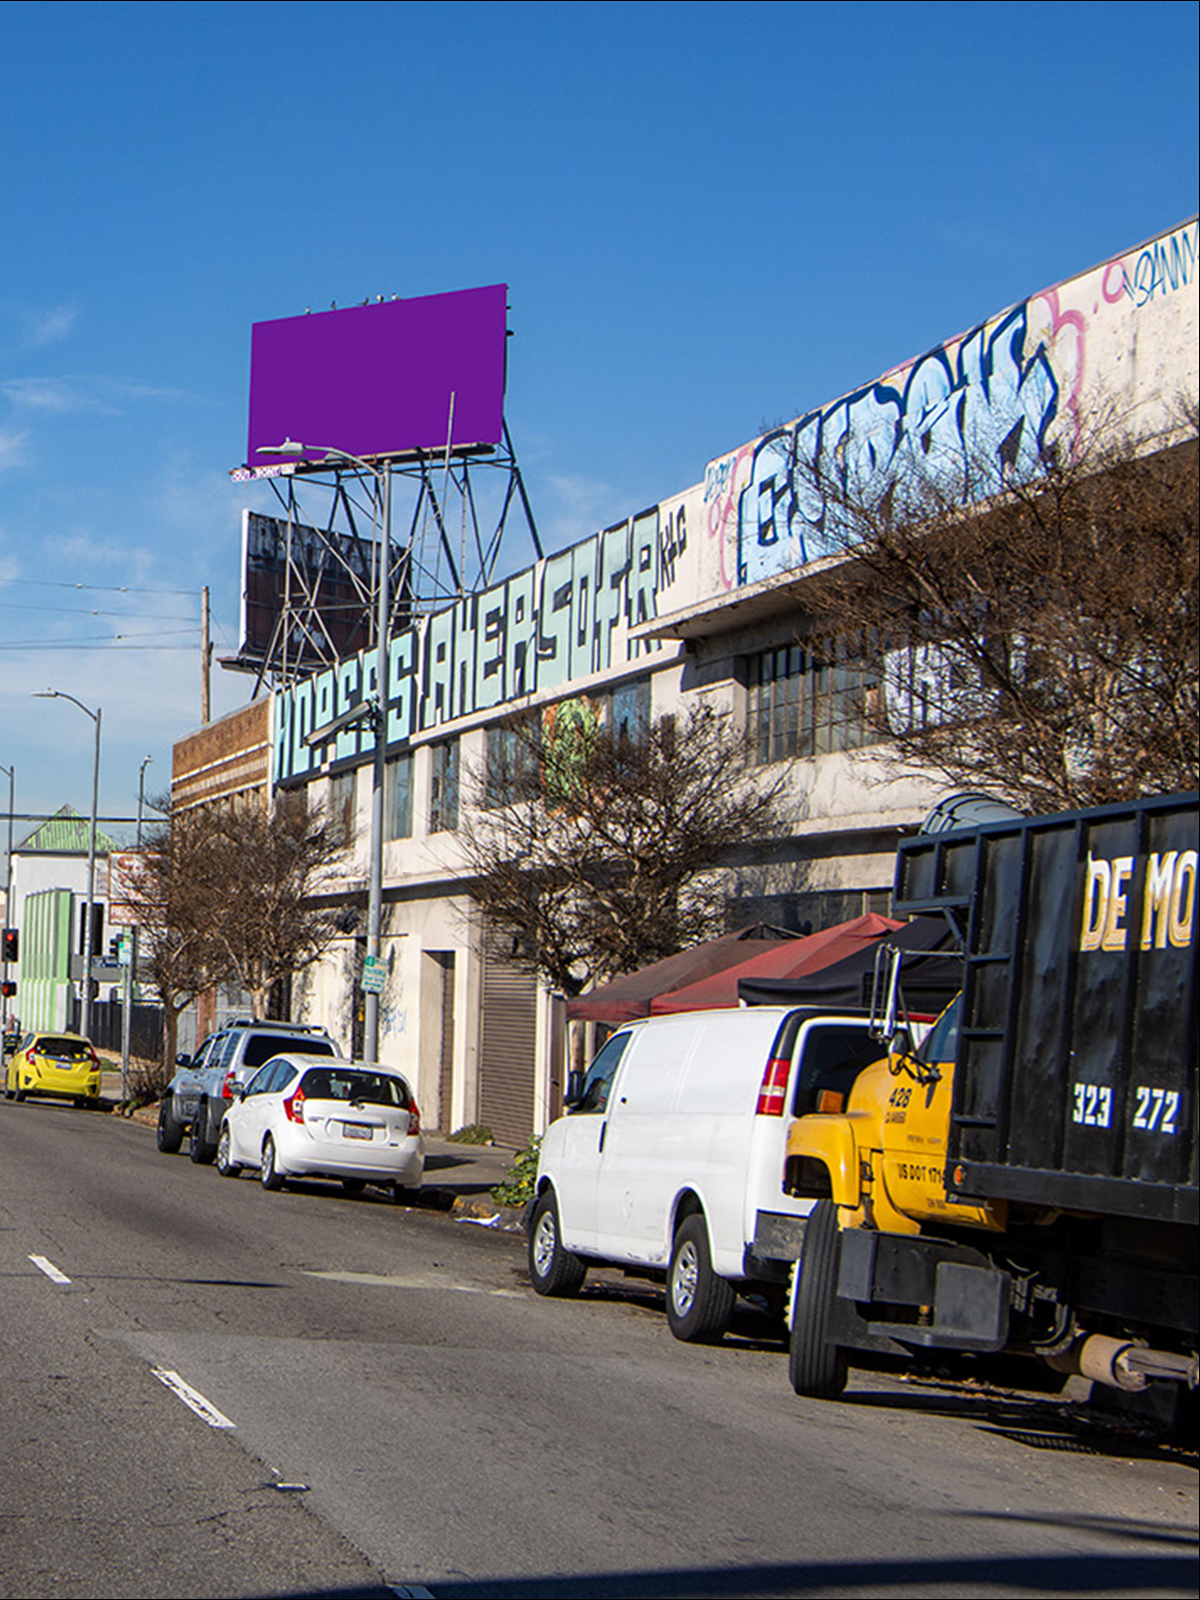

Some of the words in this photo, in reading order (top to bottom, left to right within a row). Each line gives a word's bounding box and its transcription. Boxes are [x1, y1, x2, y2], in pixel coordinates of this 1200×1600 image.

[888, 1087, 912, 1108] 428
[1072, 1082, 1113, 1130] 323
[1132, 1085, 1181, 1135] 272
[910, 1164, 926, 1182] DOT
